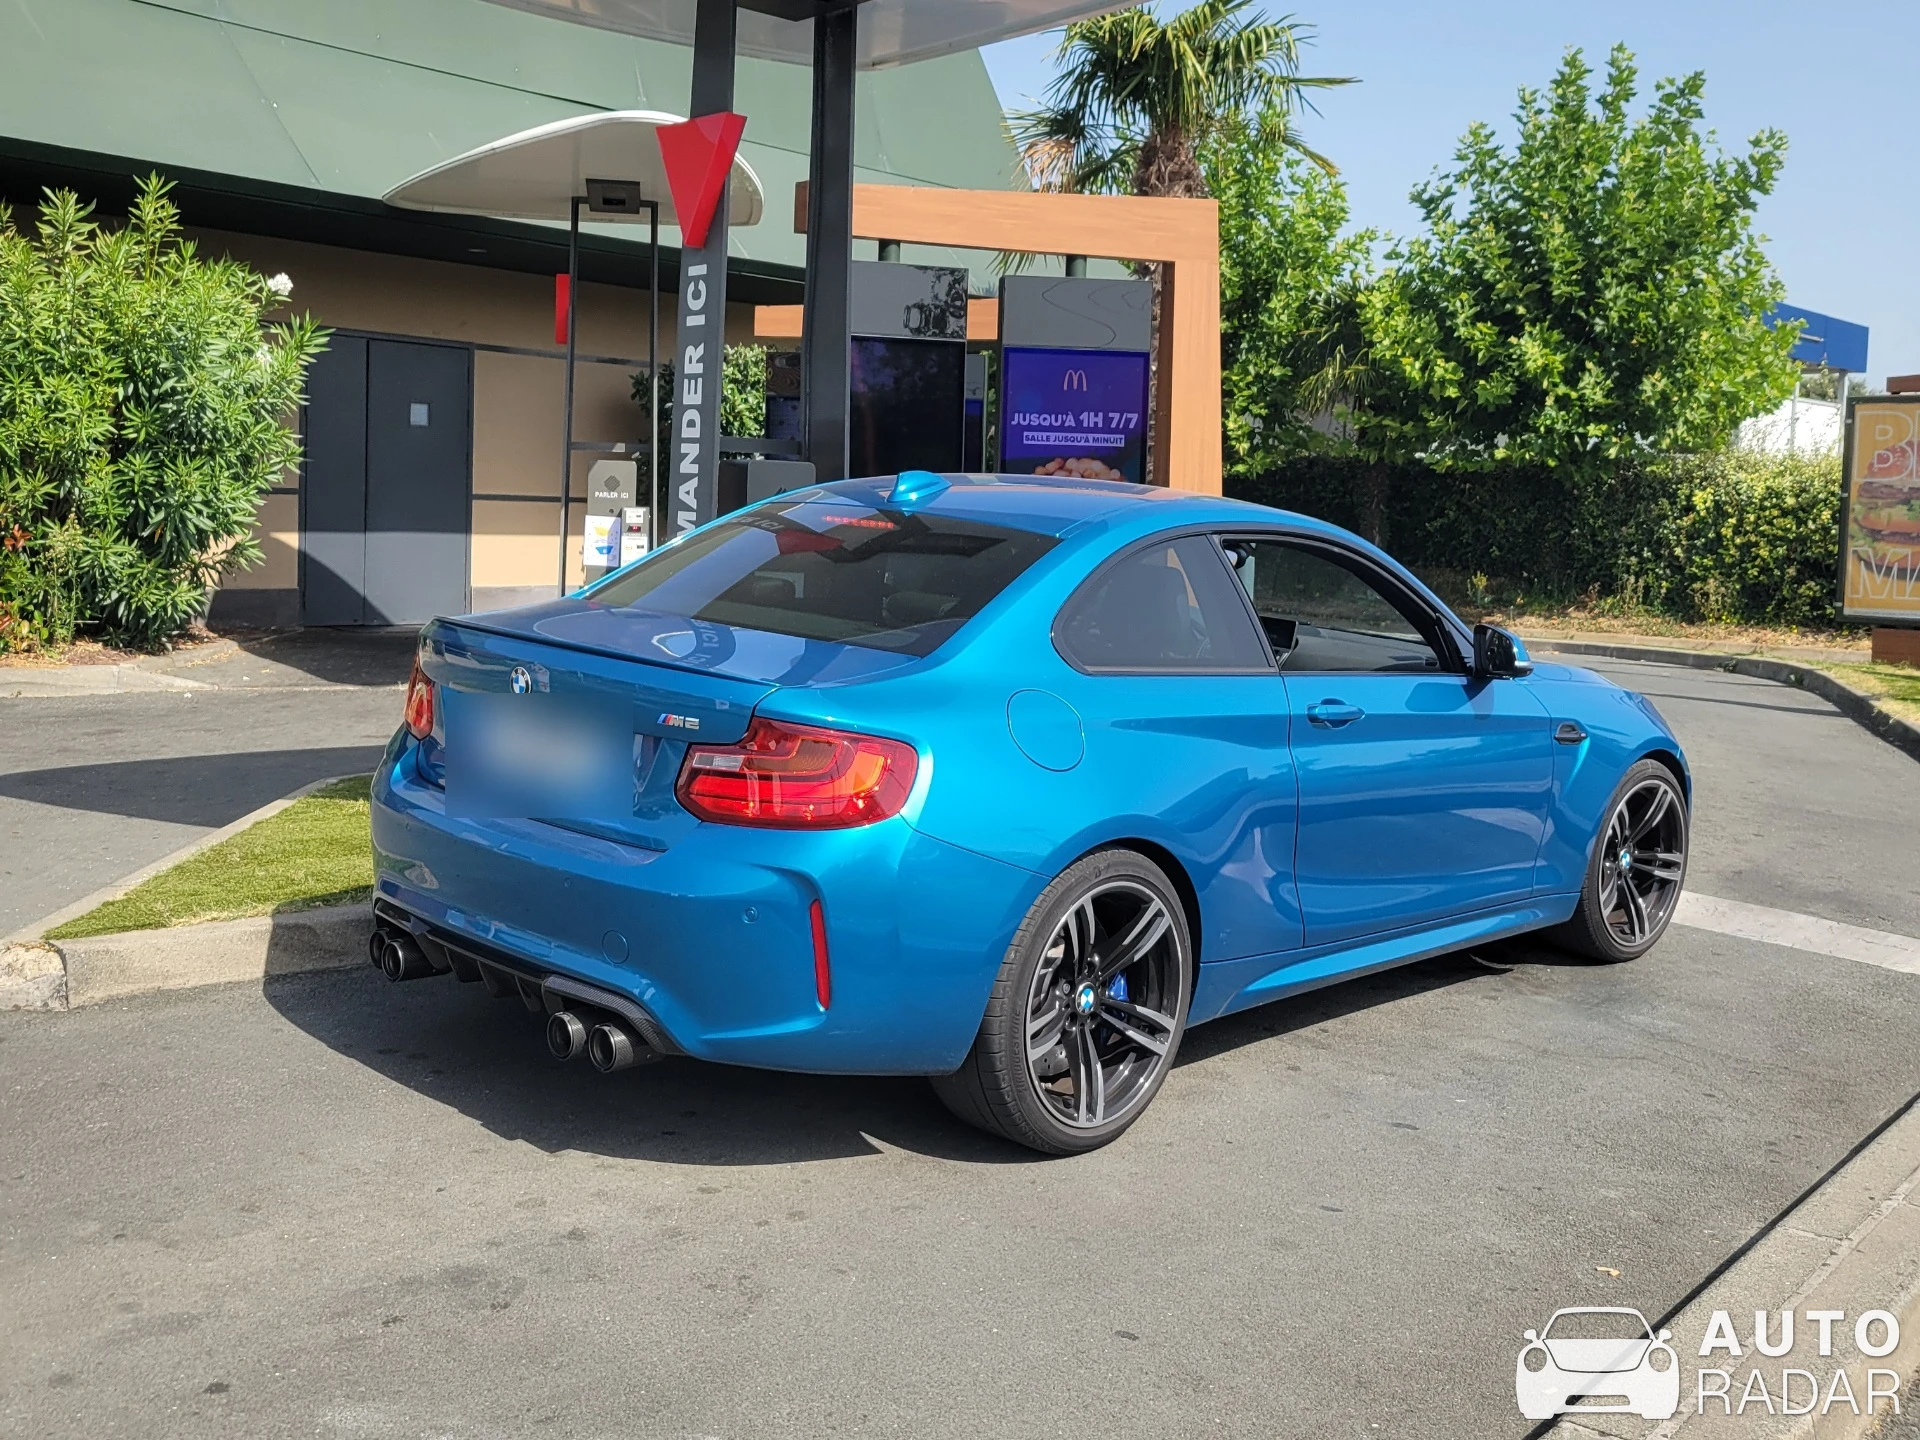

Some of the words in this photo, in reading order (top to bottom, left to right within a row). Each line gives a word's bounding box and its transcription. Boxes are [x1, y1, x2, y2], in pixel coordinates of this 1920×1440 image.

[686, 264, 708, 327] ICI
[1011, 411, 1076, 427] JUSQU'À
[1079, 411, 1103, 428] 1H
[1108, 412, 1139, 429] 7/7
[1024, 434, 1050, 443] SALLE
[1053, 435, 1090, 444] JUSQU'À
[1092, 437, 1124, 445] MINUIT
[594, 491, 618, 499] PARLER
[668, 714, 700, 730] M2
